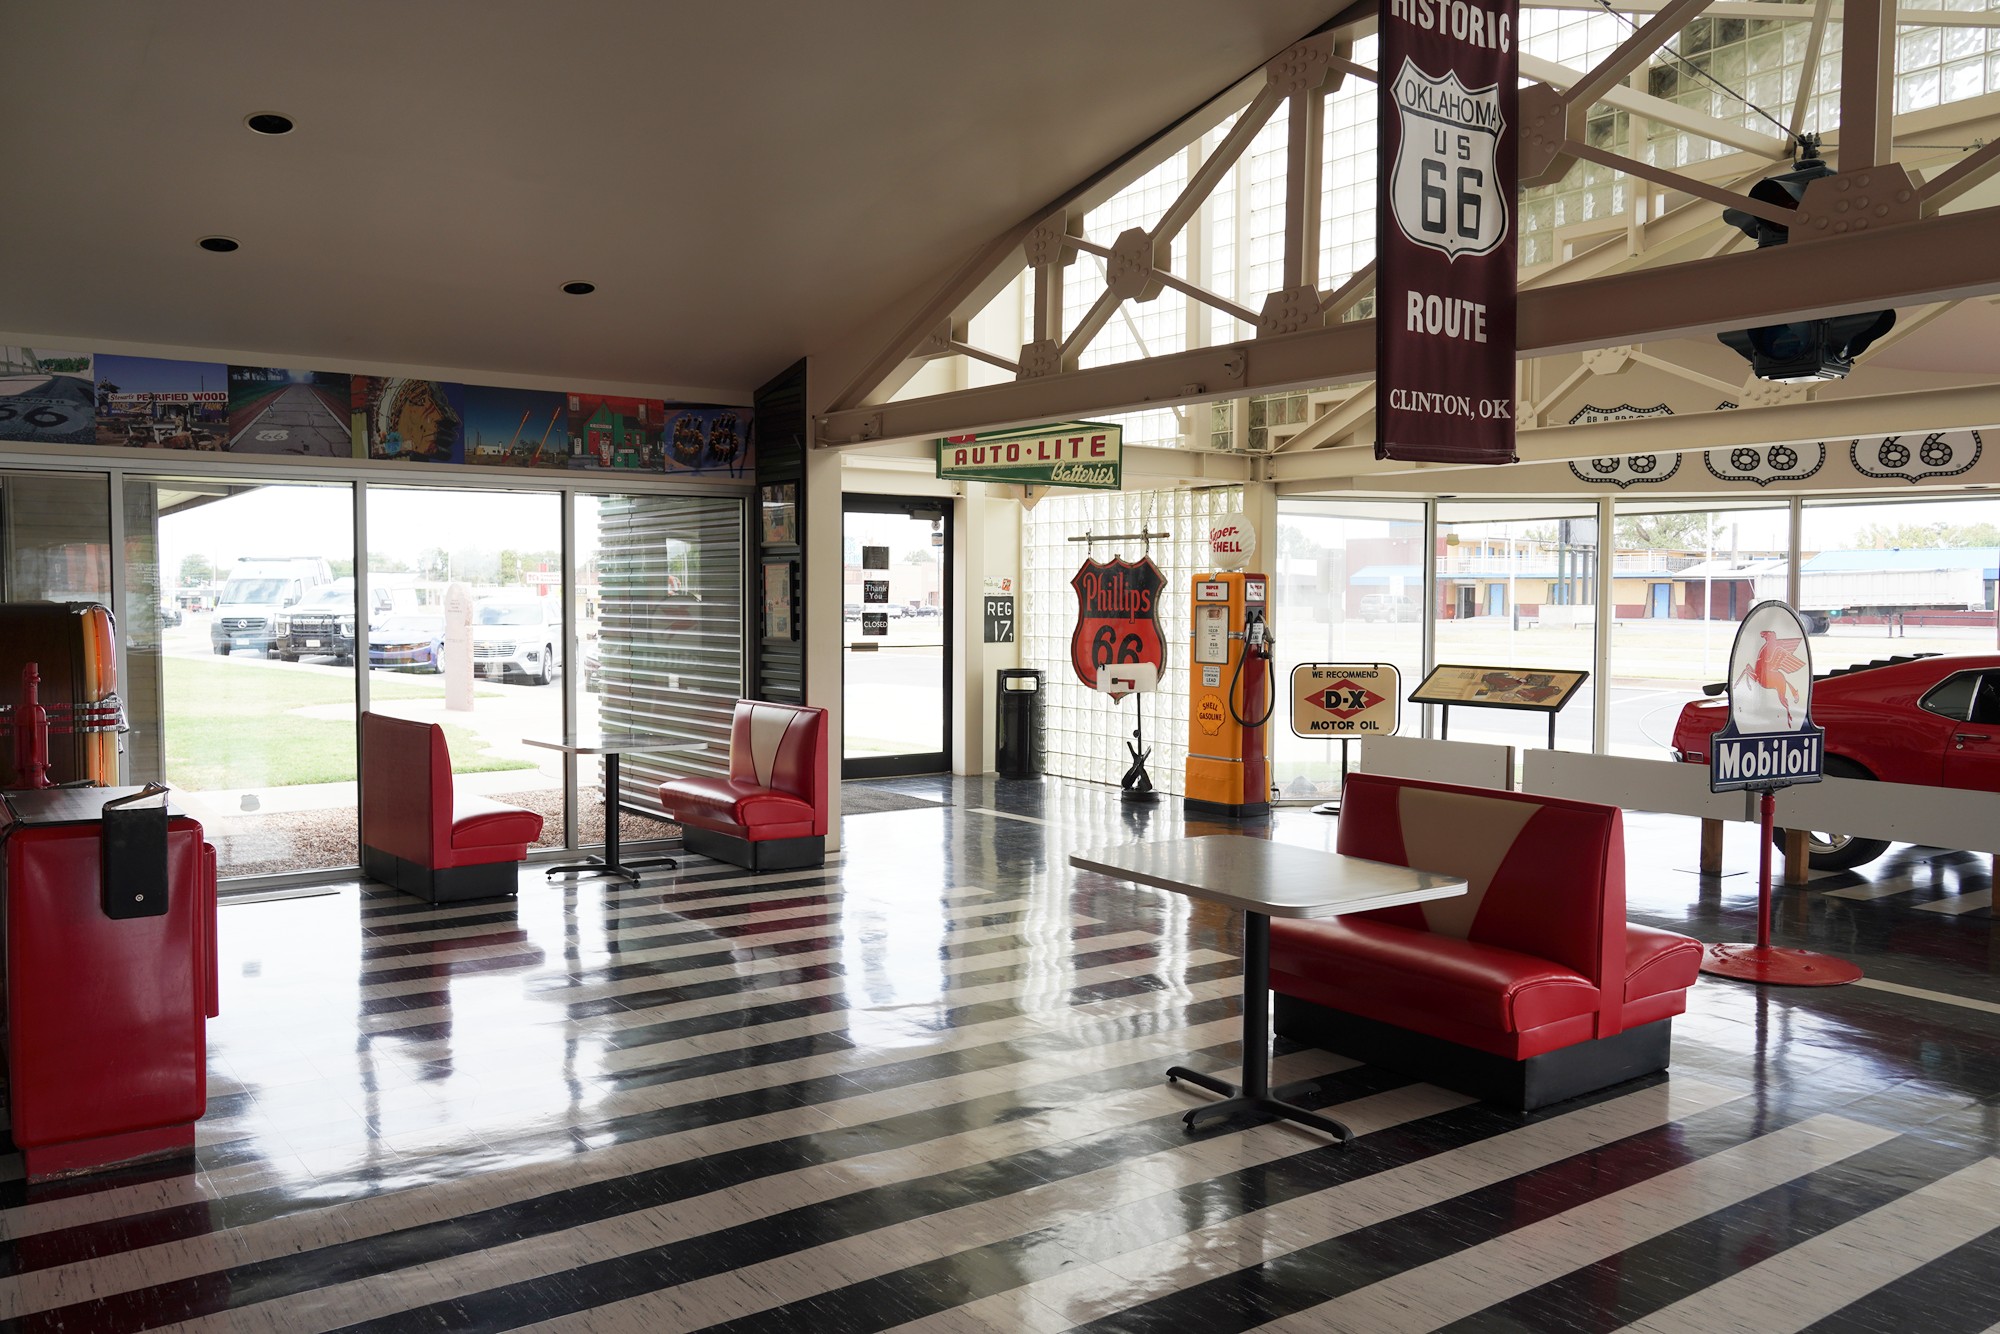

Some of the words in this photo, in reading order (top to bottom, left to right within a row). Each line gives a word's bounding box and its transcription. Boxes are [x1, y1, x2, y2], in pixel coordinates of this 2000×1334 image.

[1405, 79, 1498, 127] OKLAHOMA
[1421, 158, 1484, 240] 66
[1407, 290, 1488, 344] ROUTE
[136, 393, 189, 401] PERIFIED
[192, 392, 226, 401] WOOD
[1389, 388, 1475, 420] CLINTON,
[1479, 397, 1511, 420] OK
[260, 431, 285, 440] 66
[674, 413, 739, 461] 66
[1051, 459, 1116, 485] Batteries
[1213, 541, 1242, 553] SHELL
[865, 584, 887, 592] Thank
[869, 592, 883, 600] You
[1083, 571, 1151, 624] Phillips
[987, 601, 1012, 616] REG
[1092, 624, 1143, 667] 66
[1202, 702, 1218, 711] SHELL
[1325, 690, 1366, 709] D-X
[1199, 712, 1222, 721] GASOLINE
[1310, 721, 1354, 730] MOTOR
[1360, 721, 1379, 730] OIL
[1719, 738, 1818, 780] Mobiloil
